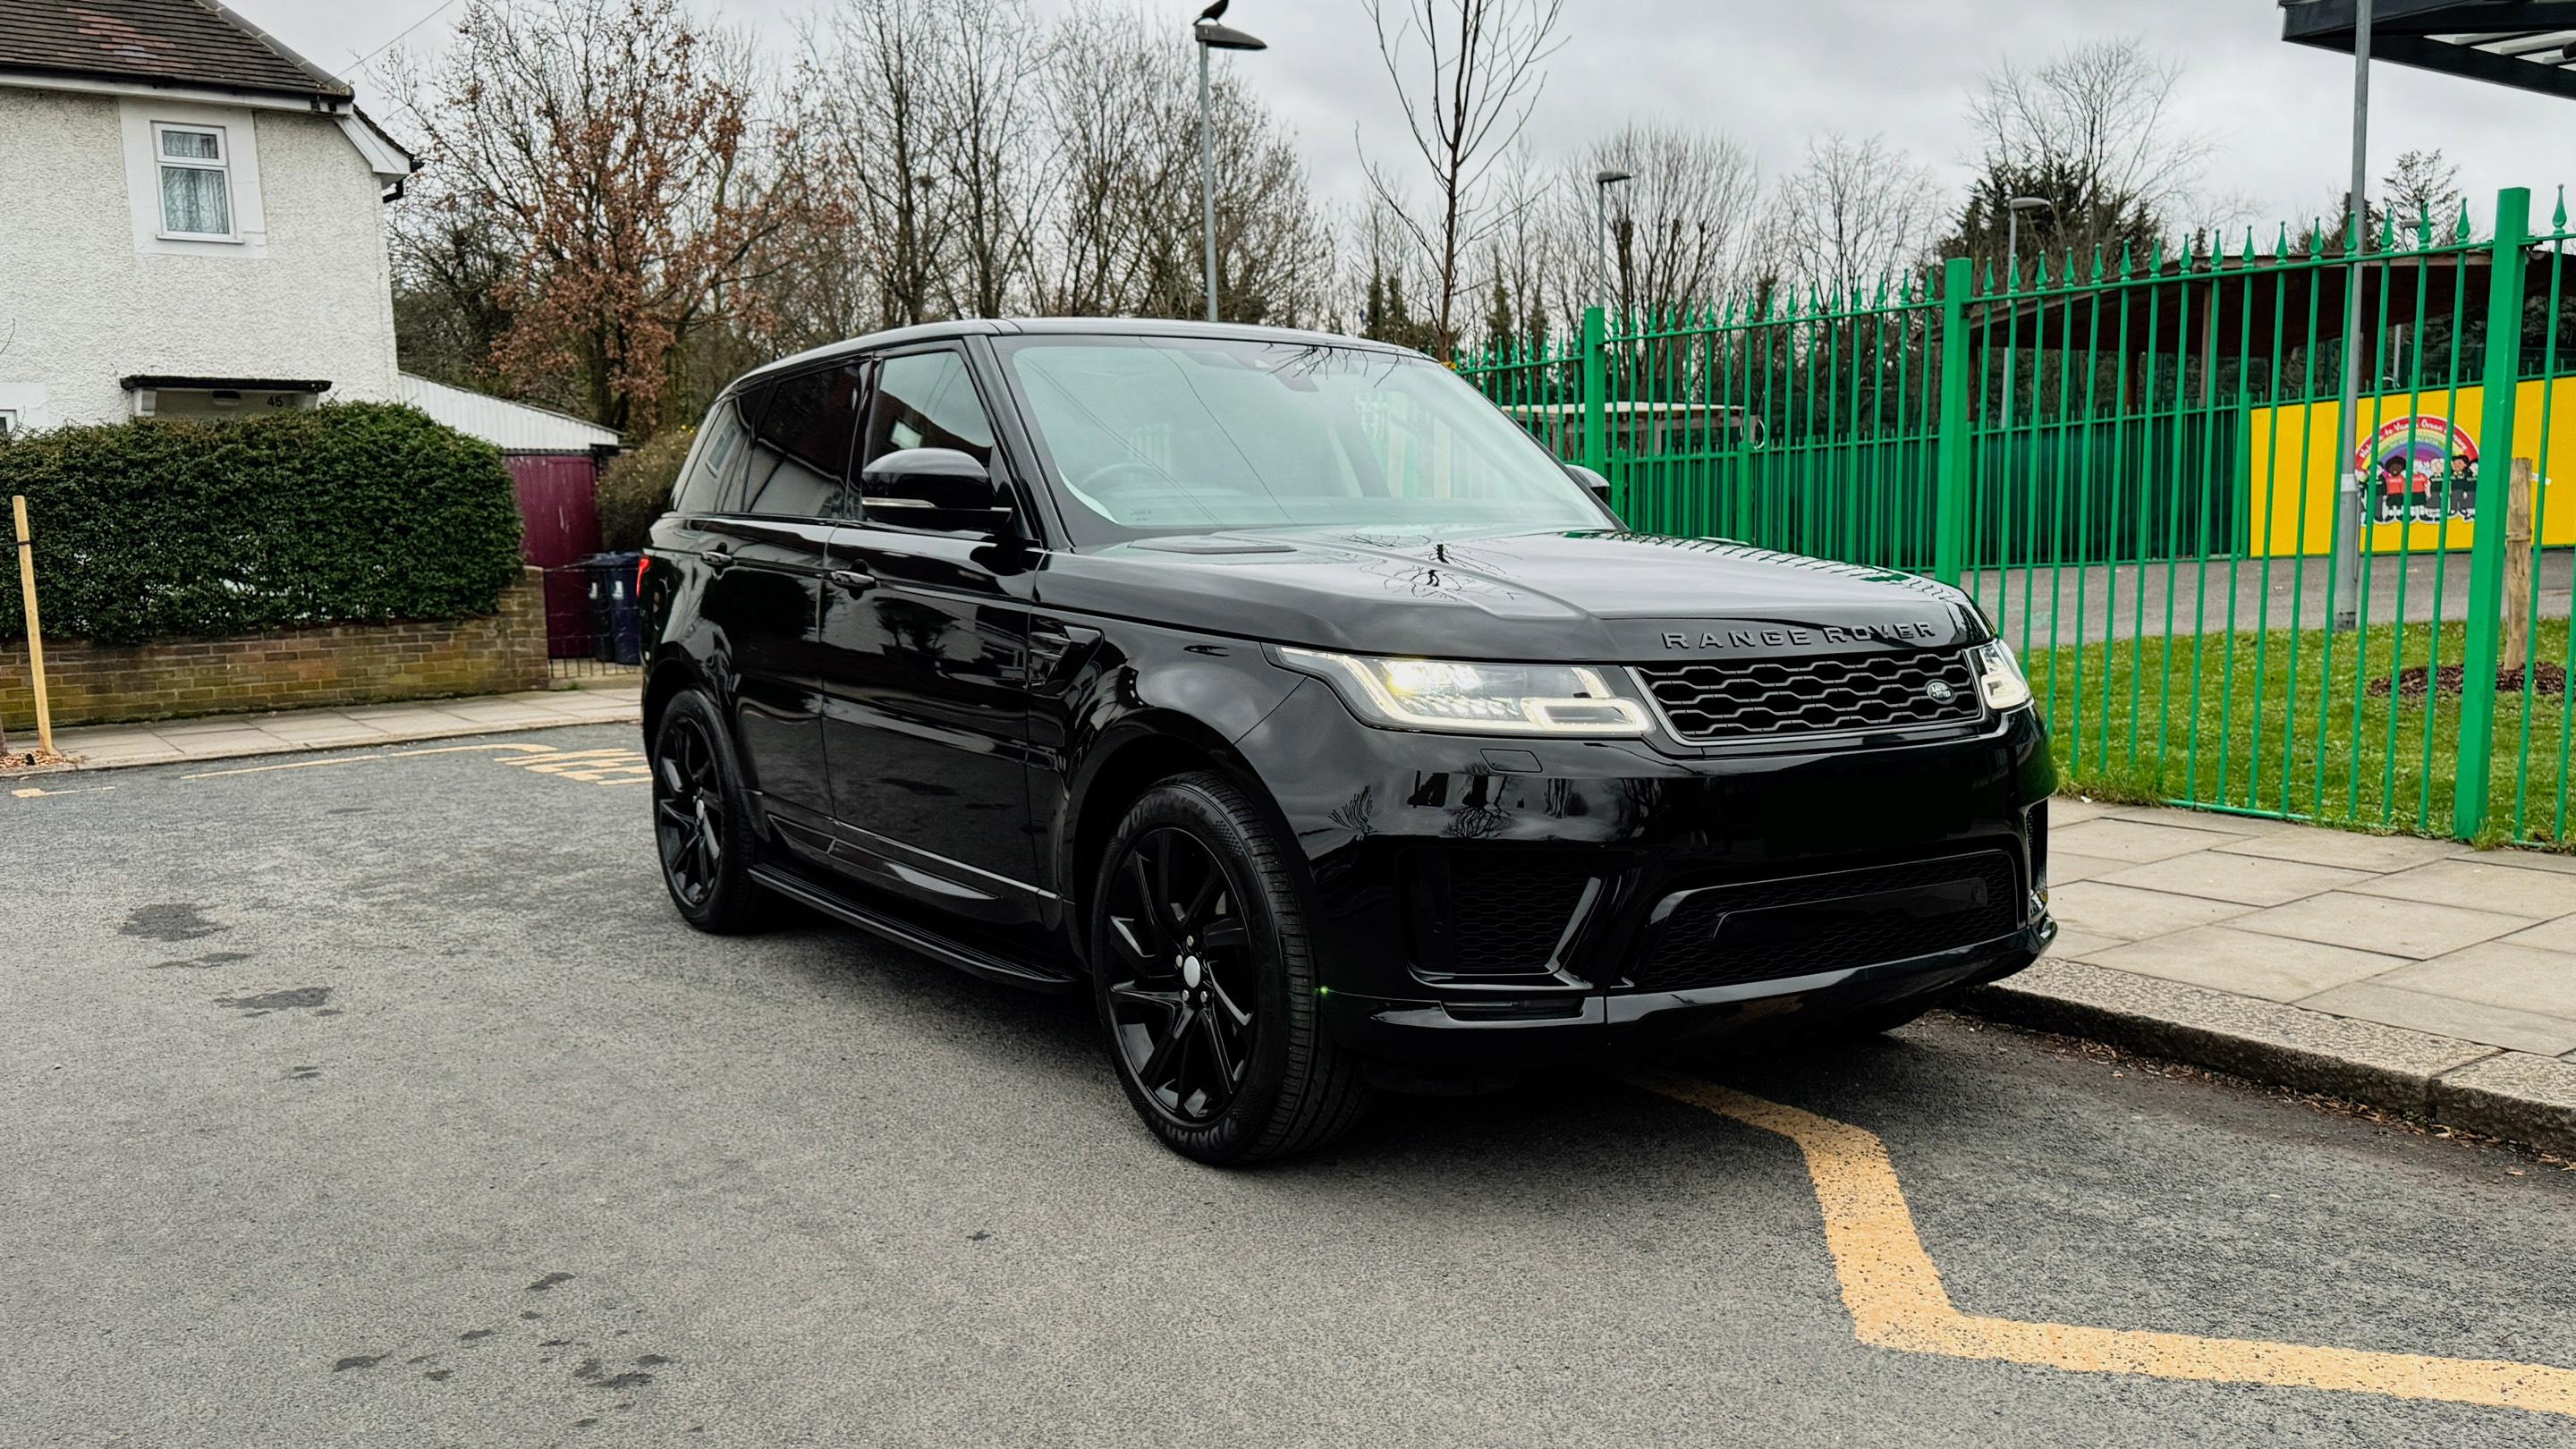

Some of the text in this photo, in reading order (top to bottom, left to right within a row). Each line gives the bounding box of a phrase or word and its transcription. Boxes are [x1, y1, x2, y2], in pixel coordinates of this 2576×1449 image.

[267, 396, 283, 408] 45
[1662, 622, 1936, 649] RANGE ROVER
